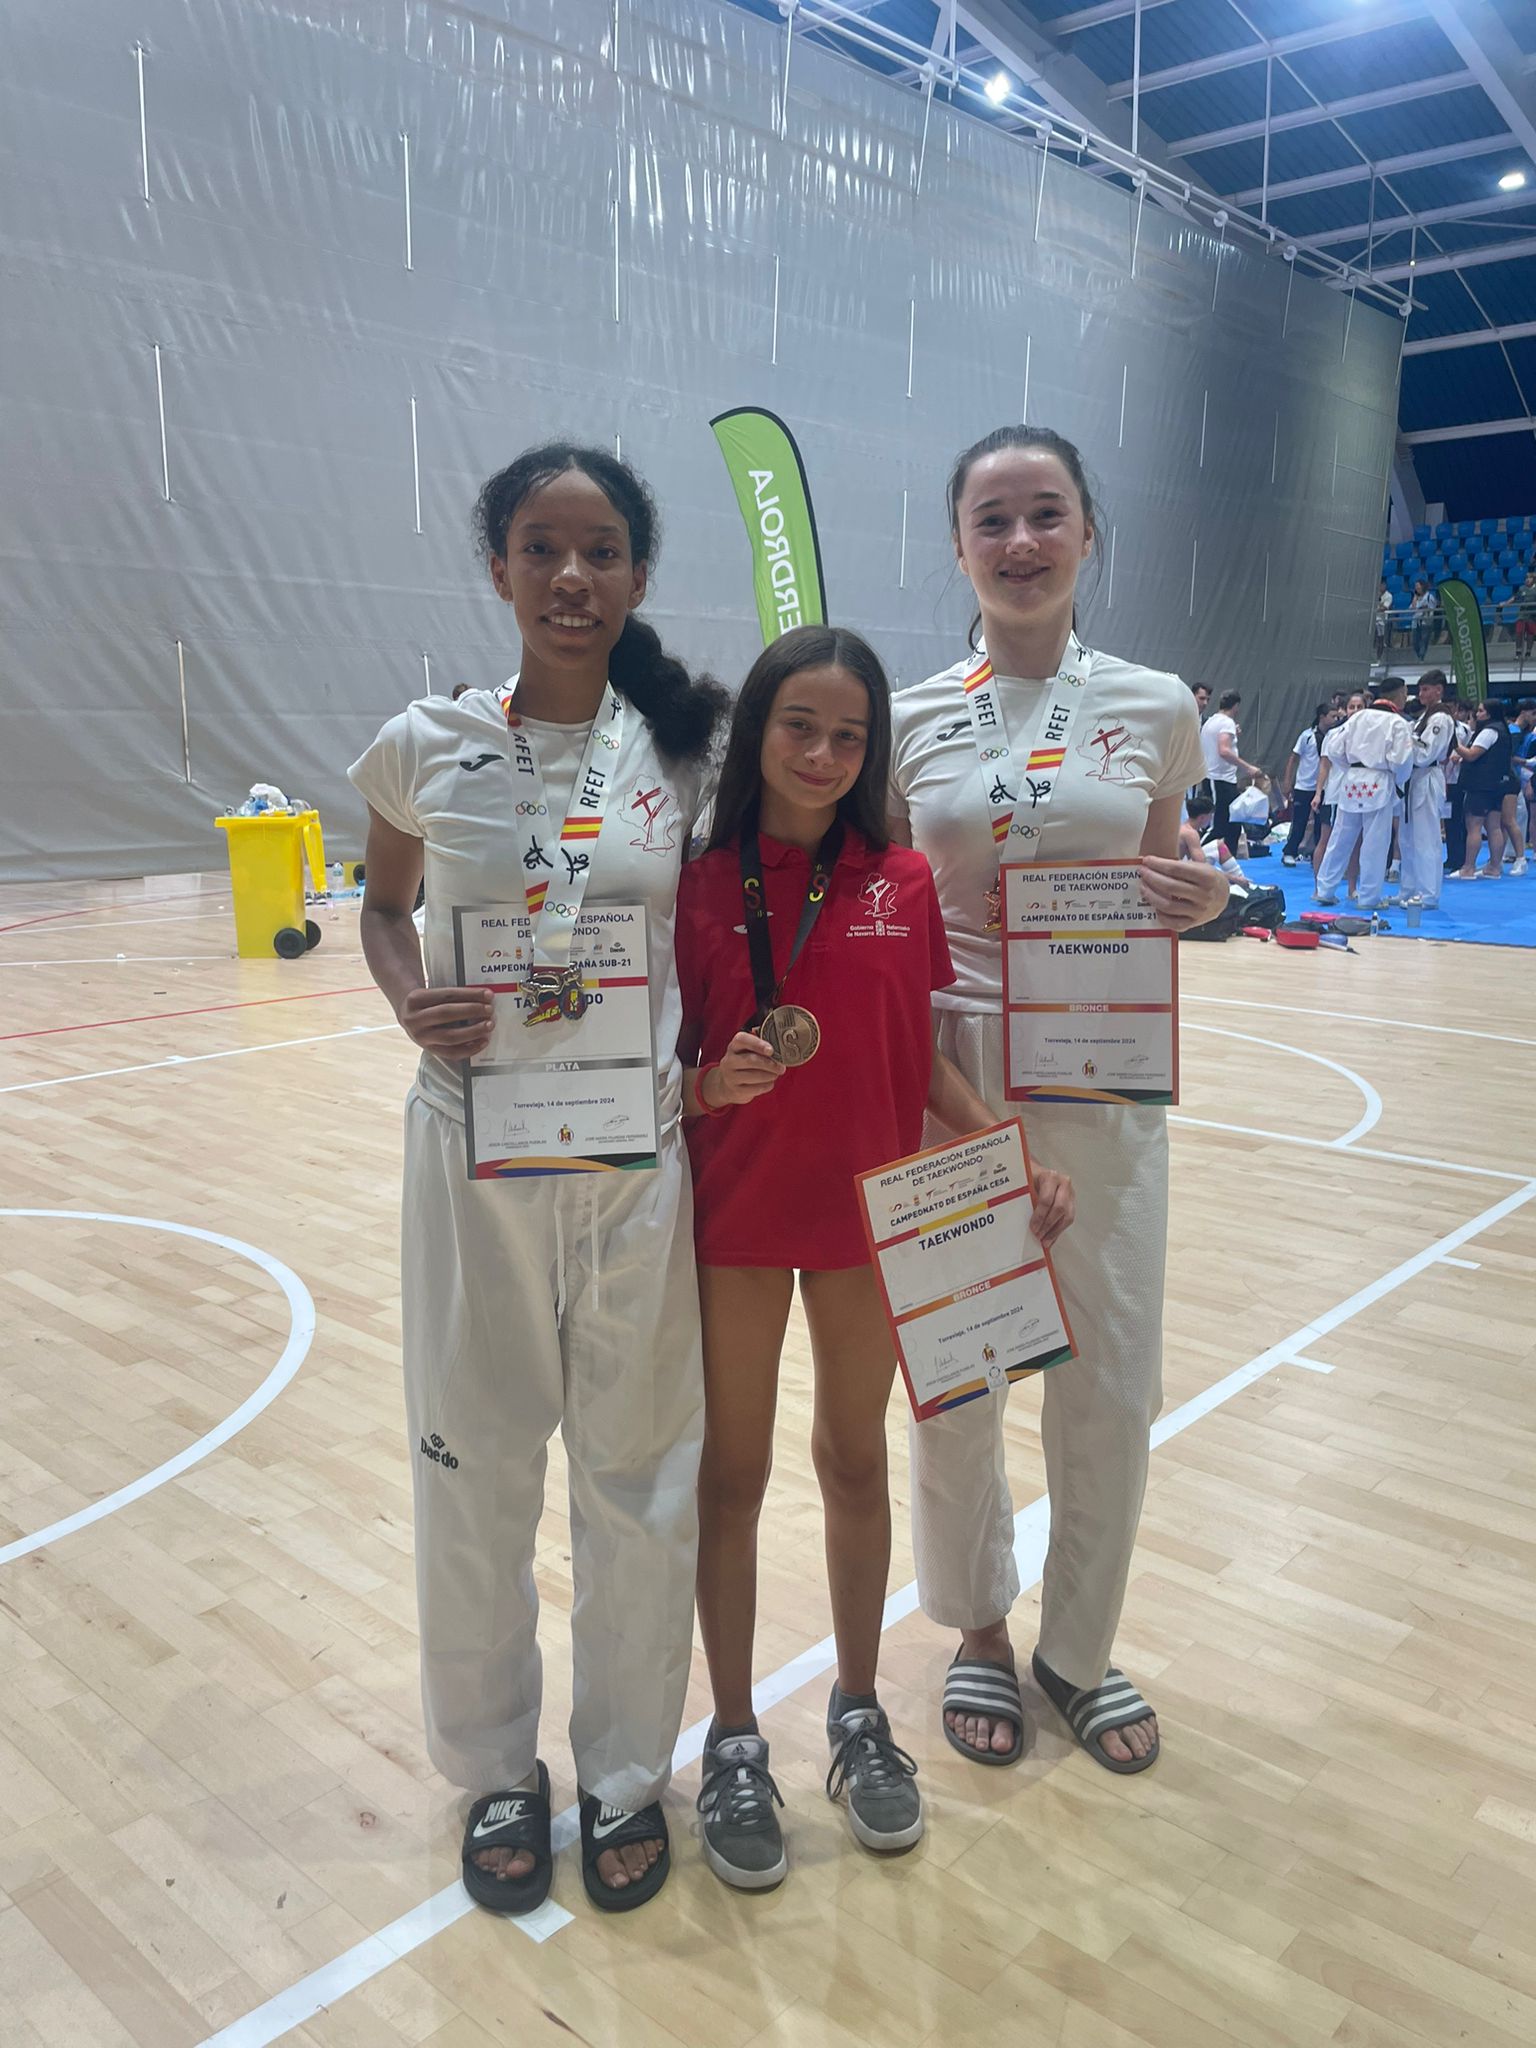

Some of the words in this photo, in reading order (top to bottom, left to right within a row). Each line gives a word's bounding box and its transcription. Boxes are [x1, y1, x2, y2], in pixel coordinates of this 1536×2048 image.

[974, 692, 997, 728] RFET
[1045, 704, 1071, 741] RFET
[513, 732, 535, 776] RFET
[580, 766, 607, 809] RFET
[1022, 874, 1047, 883] REAL
[1049, 871, 1109, 881] FEDERACIÓN
[1053, 884, 1067, 892] DE
[1069, 882, 1129, 892] TAEKWONDO
[481, 918, 508, 928] REAL
[580, 912, 634, 924] ESPAÑOLA
[1021, 913, 1077, 922] CAMPEONATO
[1079, 913, 1090, 921] DE
[1091, 911, 1125, 921] ESPAÑA
[1126, 912, 1157, 920] SUB-21
[517, 929, 532, 939] DE
[1048, 943, 1130, 955] TAEKWONDO
[599, 958, 632, 968] SUB-21
[1068, 1004, 1110, 1012] BRONCE
[545, 1061, 580, 1072] PLATA
[564, 1098, 599, 1107] septiembre
[880, 1173, 905, 1187] REAL
[905, 1151, 963, 1178] FEDERACIÓN
[964, 1134, 1011, 1156] ESPAÑOLA
[912, 1177, 925, 1187] DE
[926, 1155, 983, 1181] TAEKWONDO
[890, 1200, 944, 1227] CAMPEONATO
[945, 1196, 957, 1206] DE
[957, 1184, 989, 1201] ESPAÑA
[989, 1176, 1010, 1189] CESA
[918, 1213, 995, 1251] TAEKWONDO
[953, 1281, 992, 1302] BRONCE
[483, 1799, 526, 1823] NIKE
